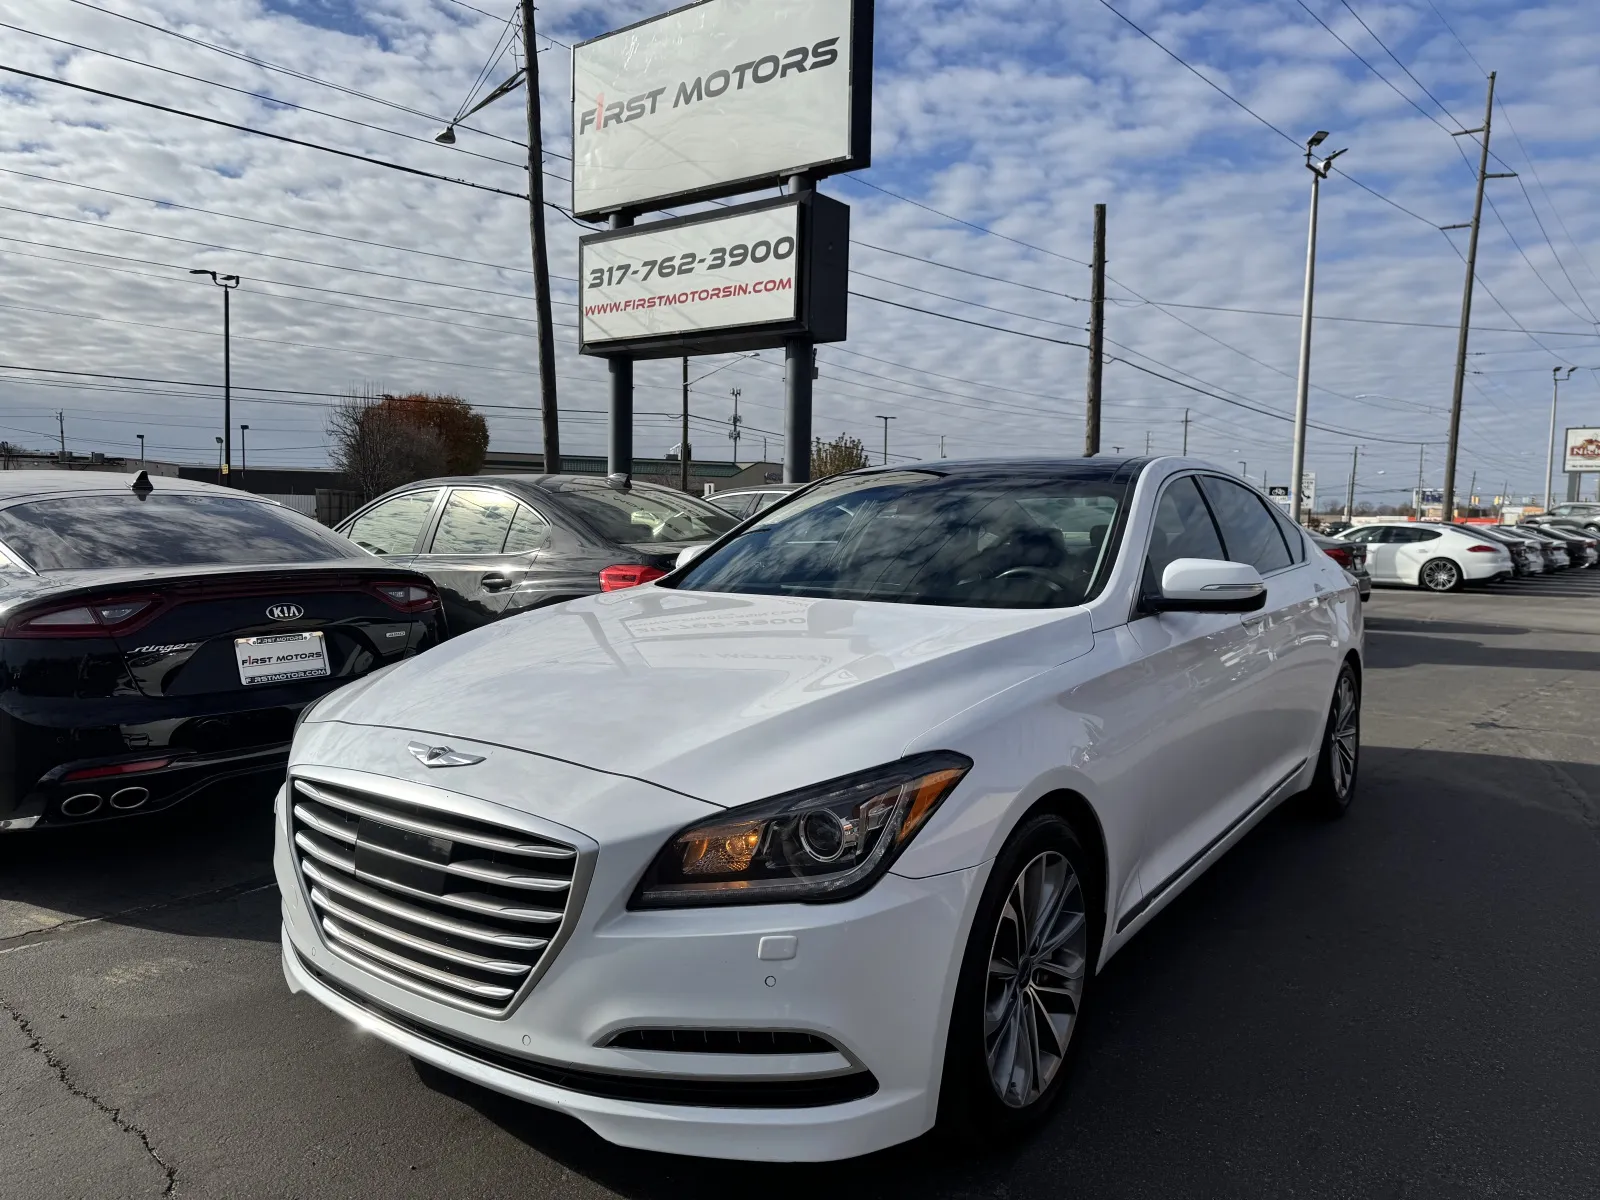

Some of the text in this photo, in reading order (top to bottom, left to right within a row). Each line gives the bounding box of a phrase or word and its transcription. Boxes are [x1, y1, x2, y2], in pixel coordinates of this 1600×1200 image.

[672, 36, 840, 109] MOTORS
[587, 236, 795, 289] 317-762-3900
[584, 277, 792, 317] WWW.FIRSTMOTORSIN.COM
[272, 605, 300, 618] KIA
[276, 651, 322, 662] MOTORS
